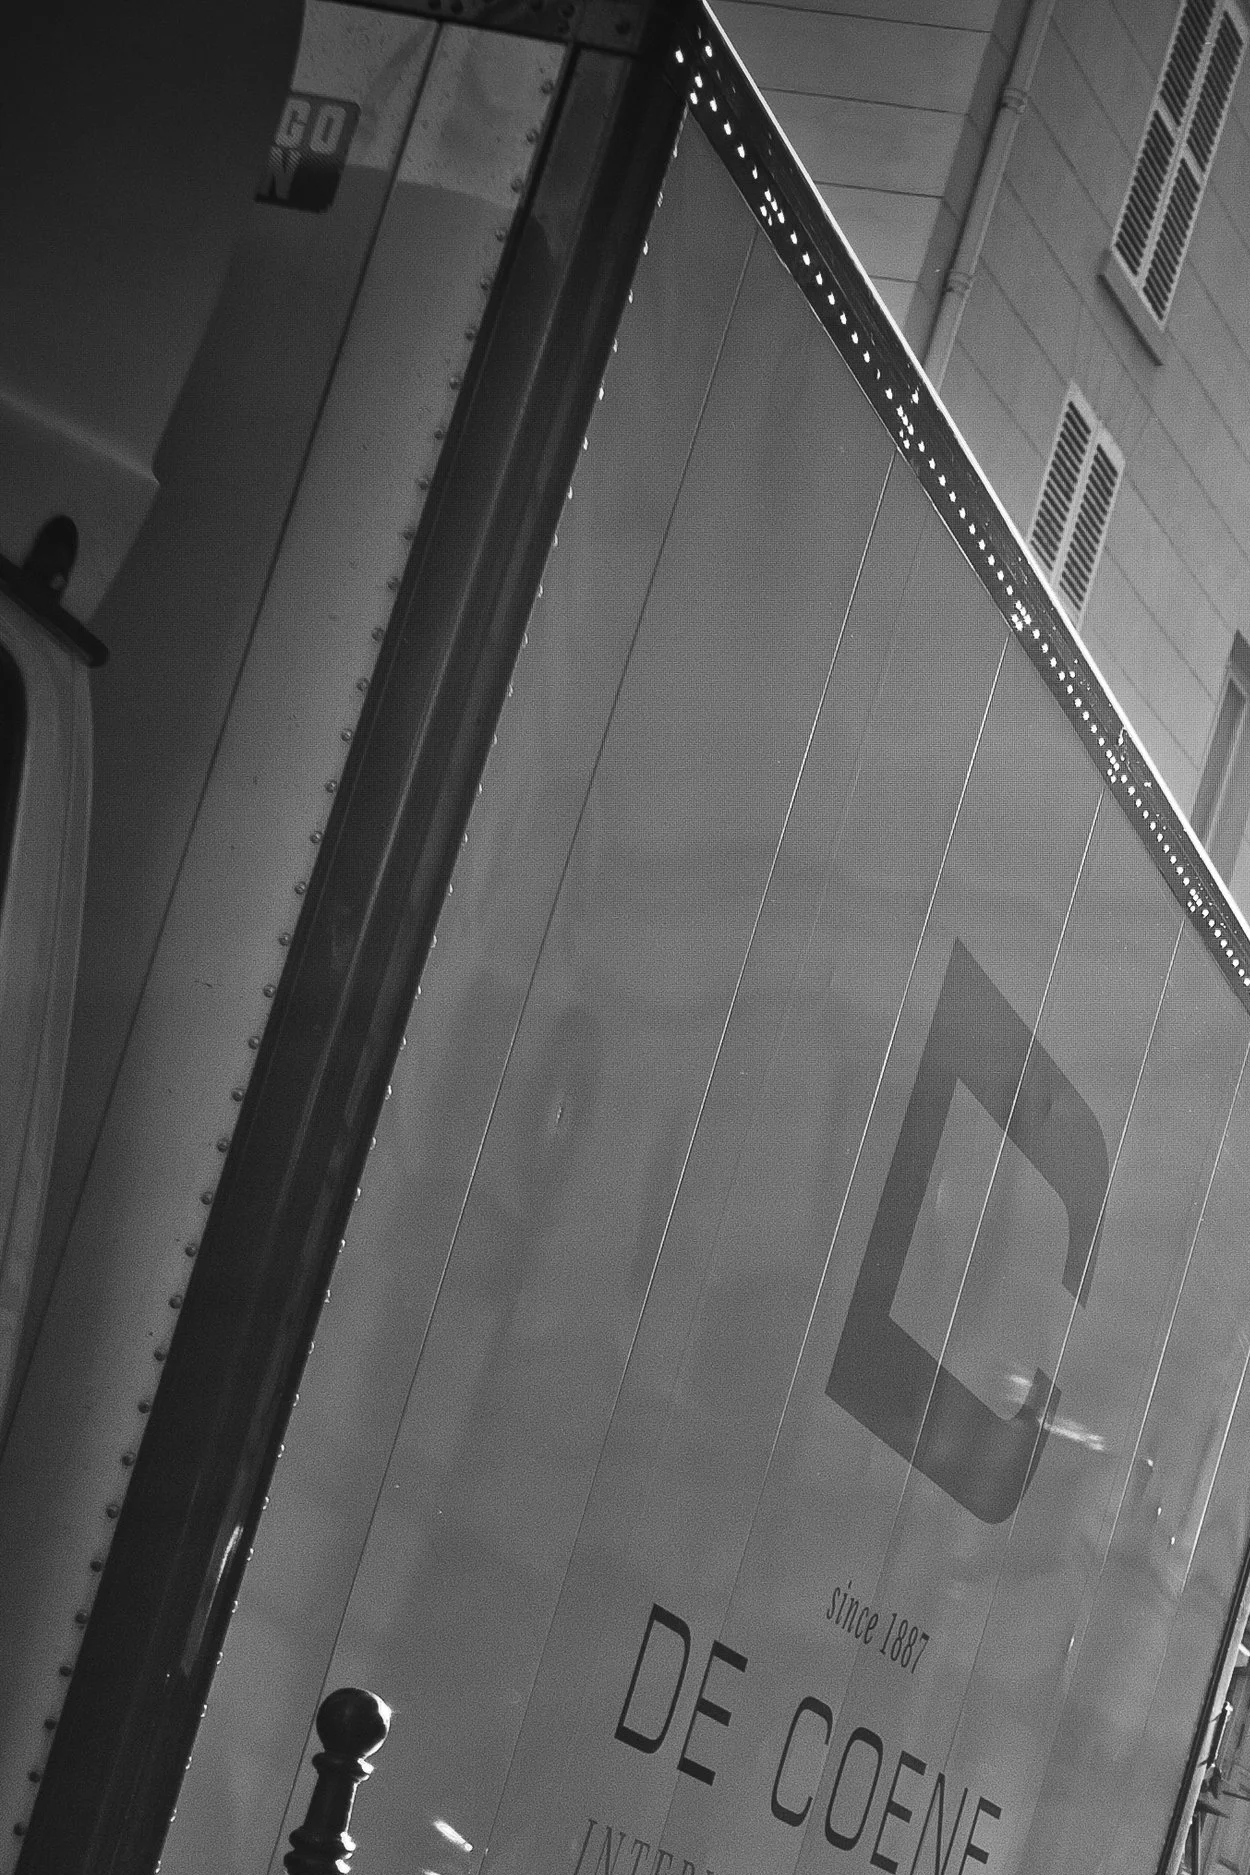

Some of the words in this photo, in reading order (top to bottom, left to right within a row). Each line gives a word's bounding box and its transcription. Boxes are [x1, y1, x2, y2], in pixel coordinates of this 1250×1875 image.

[614, 1602, 749, 1786] DE
[826, 1580, 879, 1645] since
[878, 1612, 930, 1674] 1887
